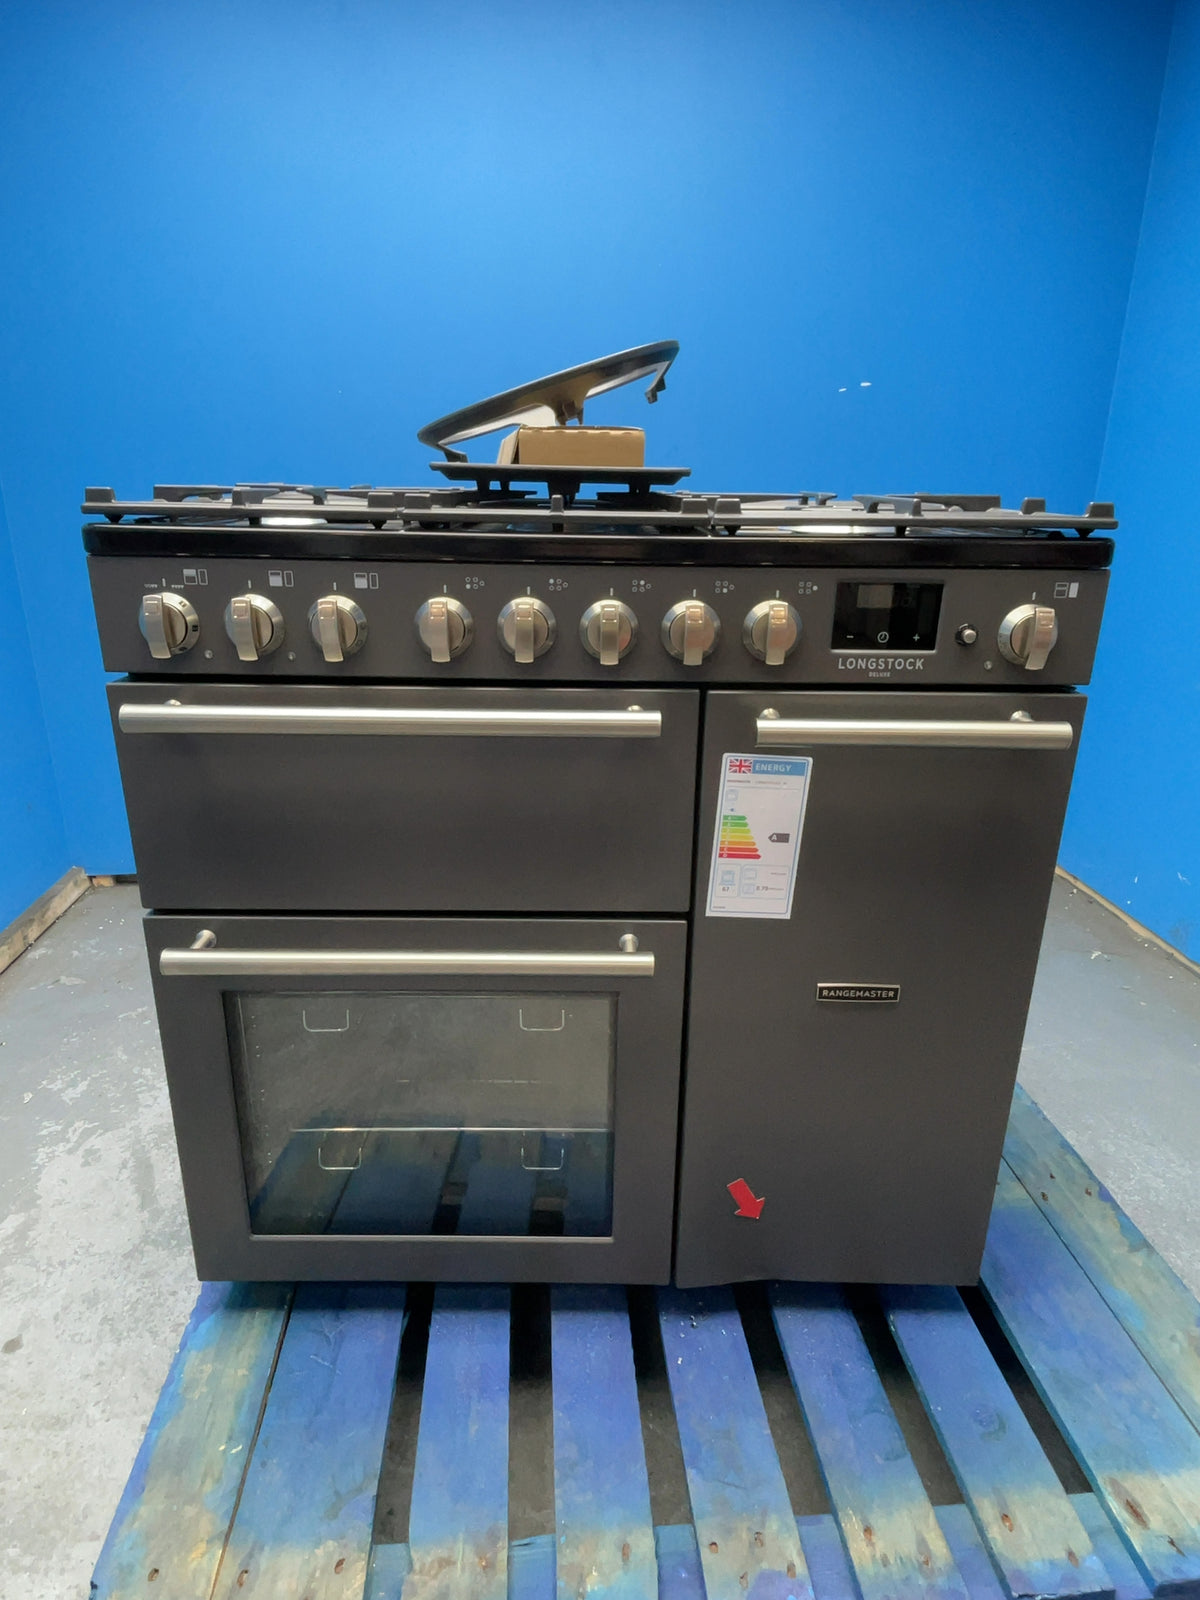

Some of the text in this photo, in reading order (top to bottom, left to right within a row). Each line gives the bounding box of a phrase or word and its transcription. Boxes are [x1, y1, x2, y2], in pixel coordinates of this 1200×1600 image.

[838, 658, 924, 670] LONGSTOCK
[755, 763, 792, 772] ENERGY
[822, 989, 895, 998] RANGEMASTER
